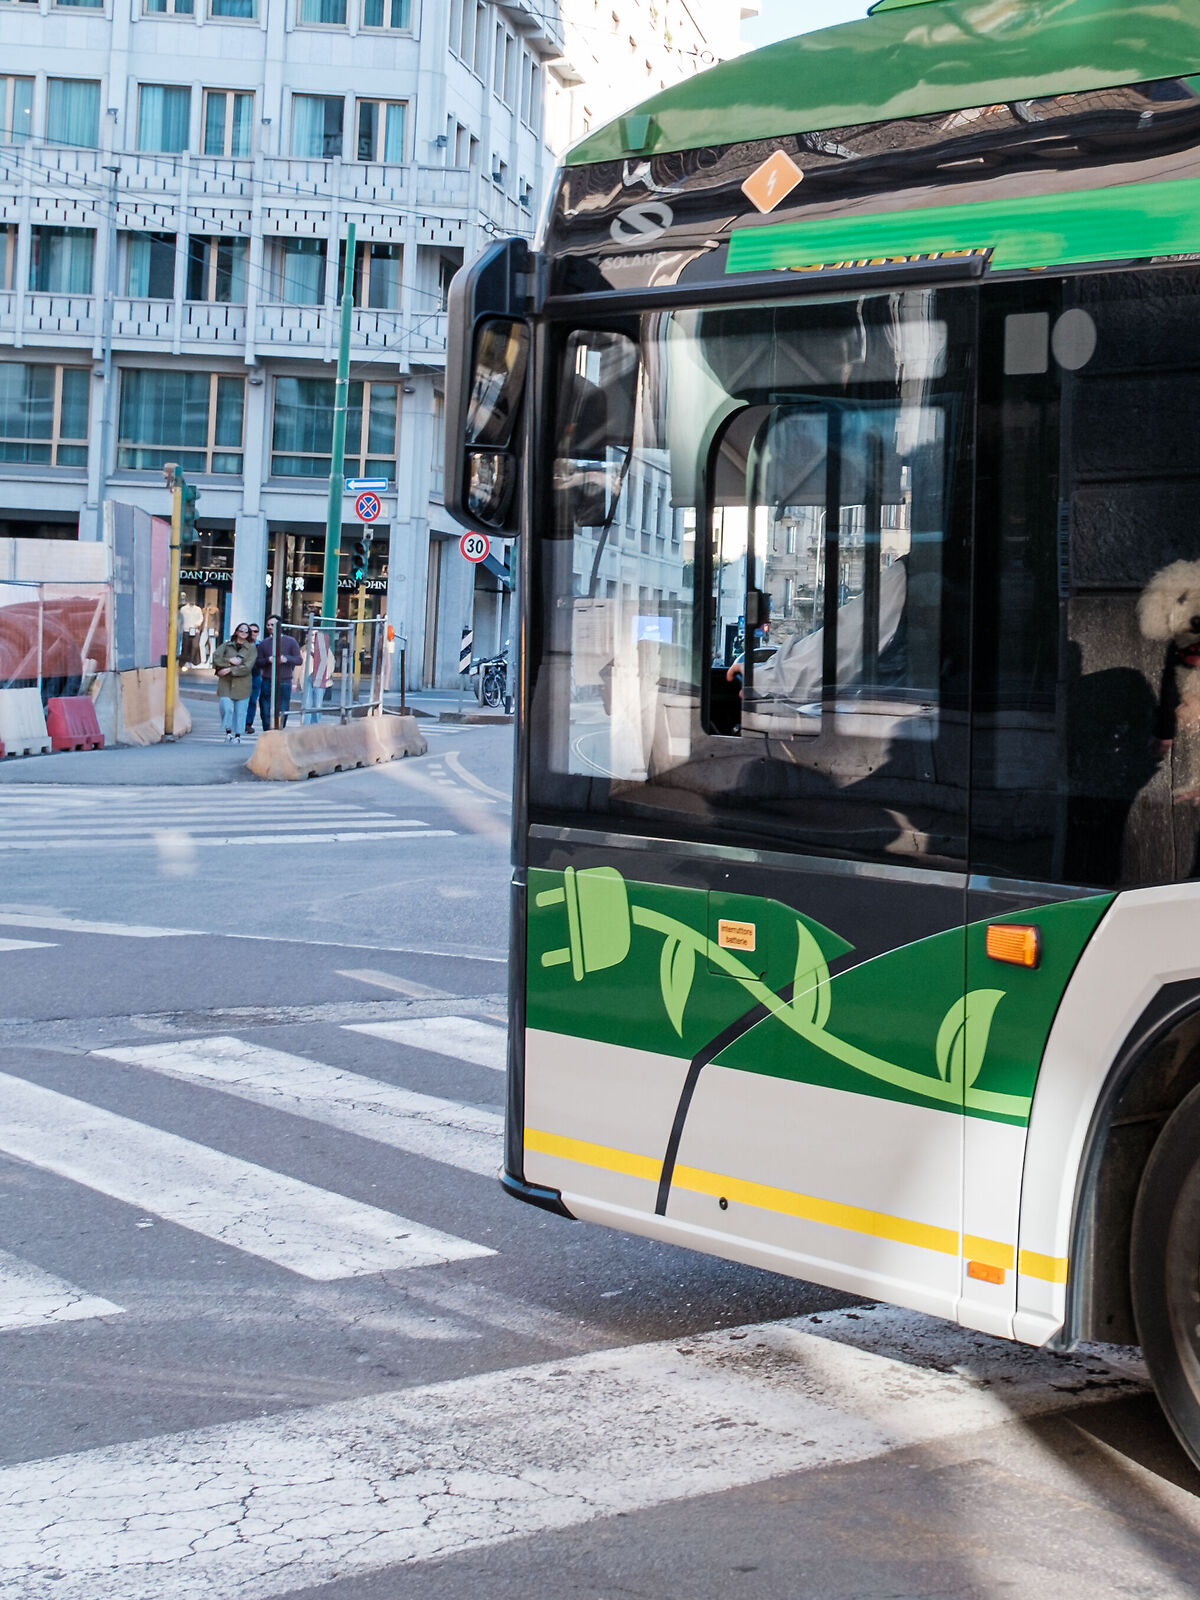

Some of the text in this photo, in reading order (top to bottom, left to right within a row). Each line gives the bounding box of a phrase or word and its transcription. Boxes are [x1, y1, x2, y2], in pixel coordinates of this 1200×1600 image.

[467, 538, 484, 554] 30
[179, 570, 233, 583] DAN JOHN
